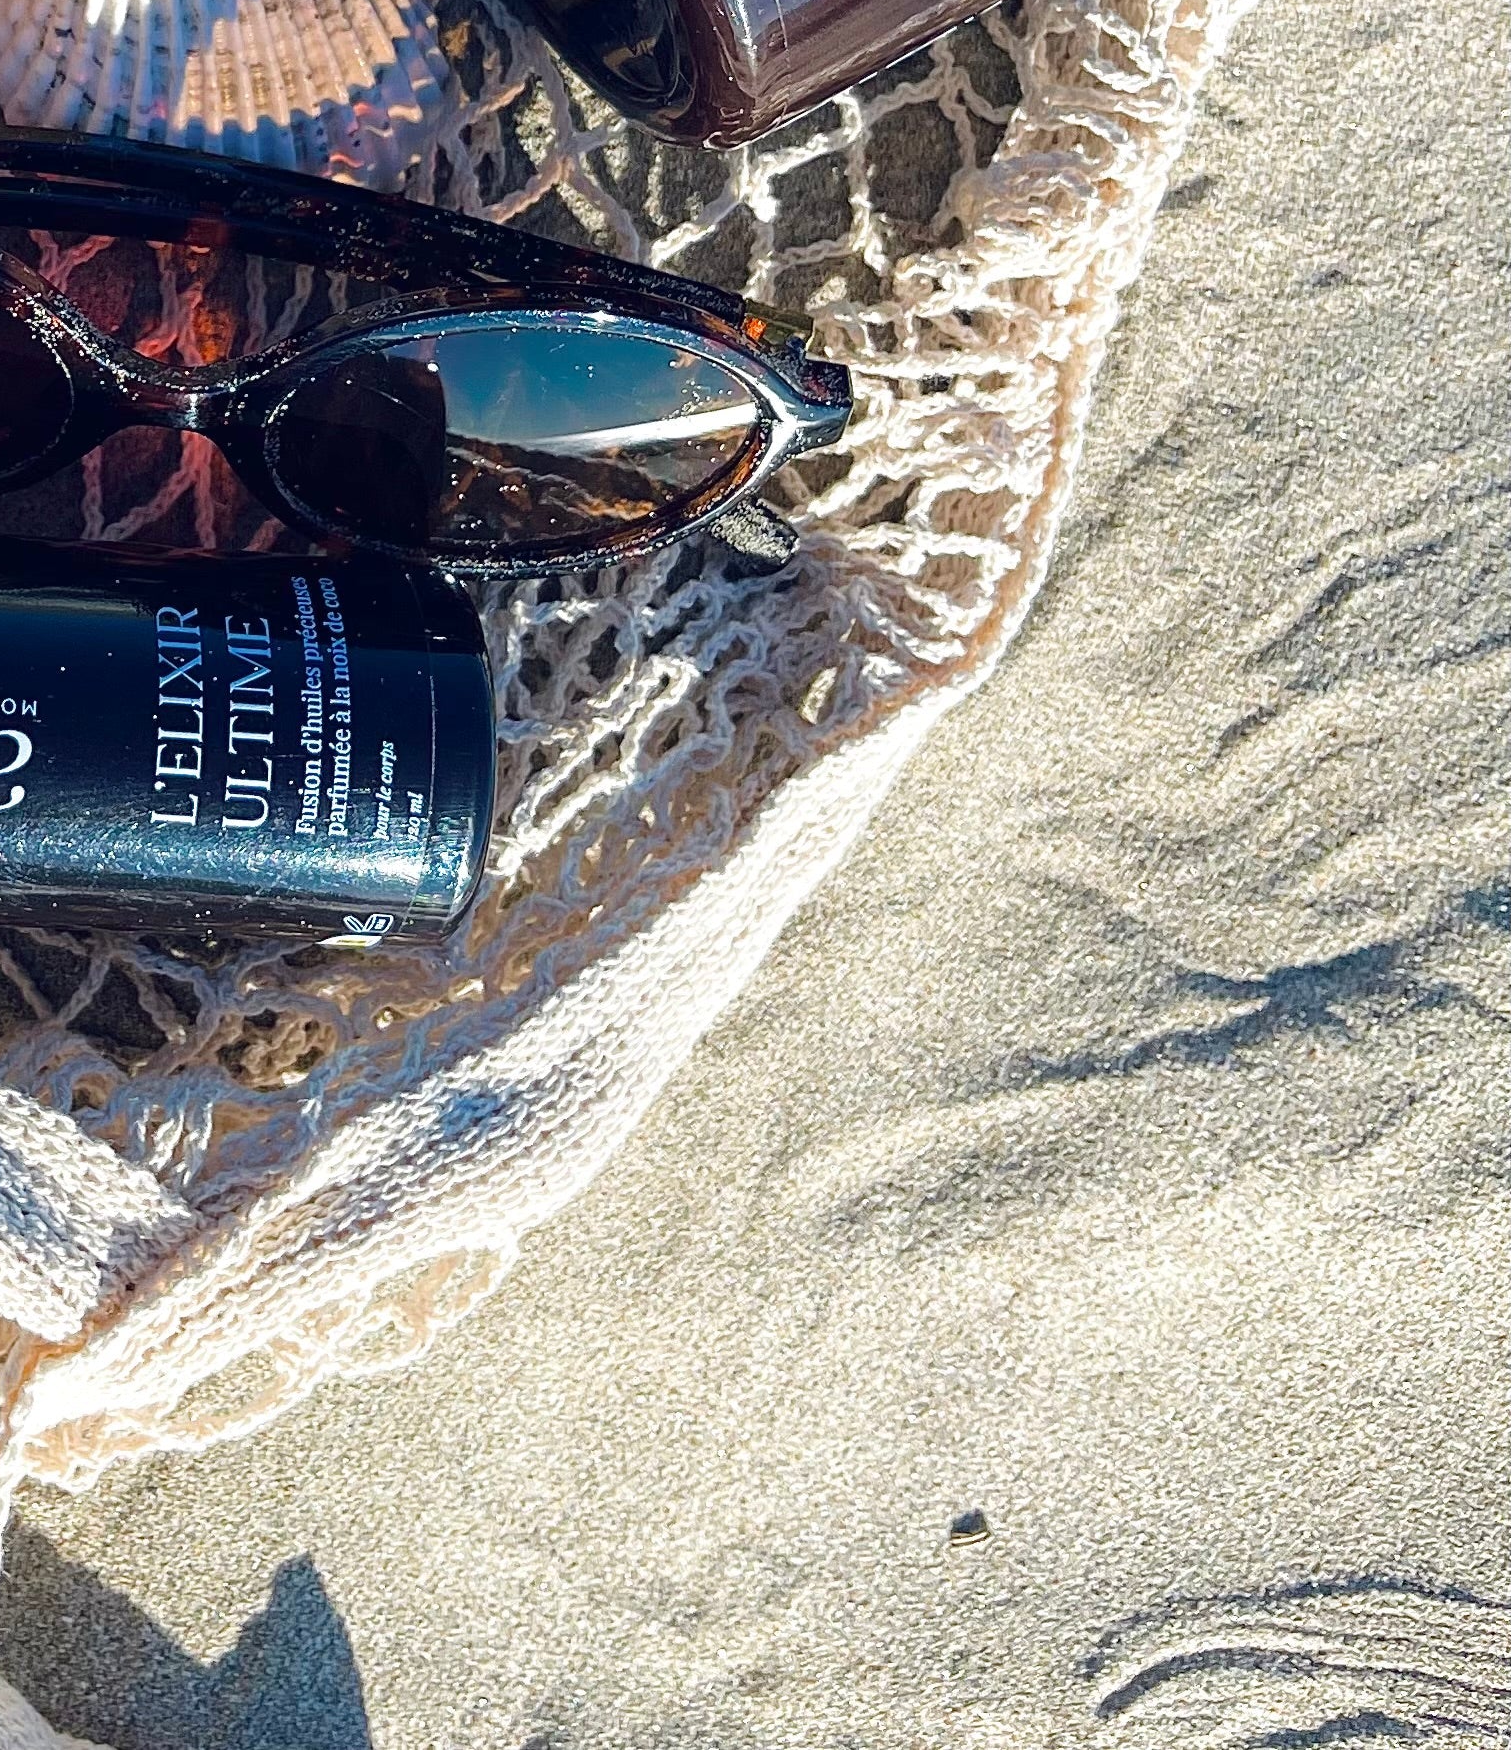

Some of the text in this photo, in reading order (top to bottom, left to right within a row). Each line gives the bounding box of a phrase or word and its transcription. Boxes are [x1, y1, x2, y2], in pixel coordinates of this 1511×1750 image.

[290, 576, 324, 662] précieuses
[221, 615, 274, 829] ULTIME
[318, 577, 352, 838] parfumée à la noix de coco
[295, 758, 322, 836] Fusion
[373, 740, 397, 842] pour le corps
[407, 791, 424, 814] ml
